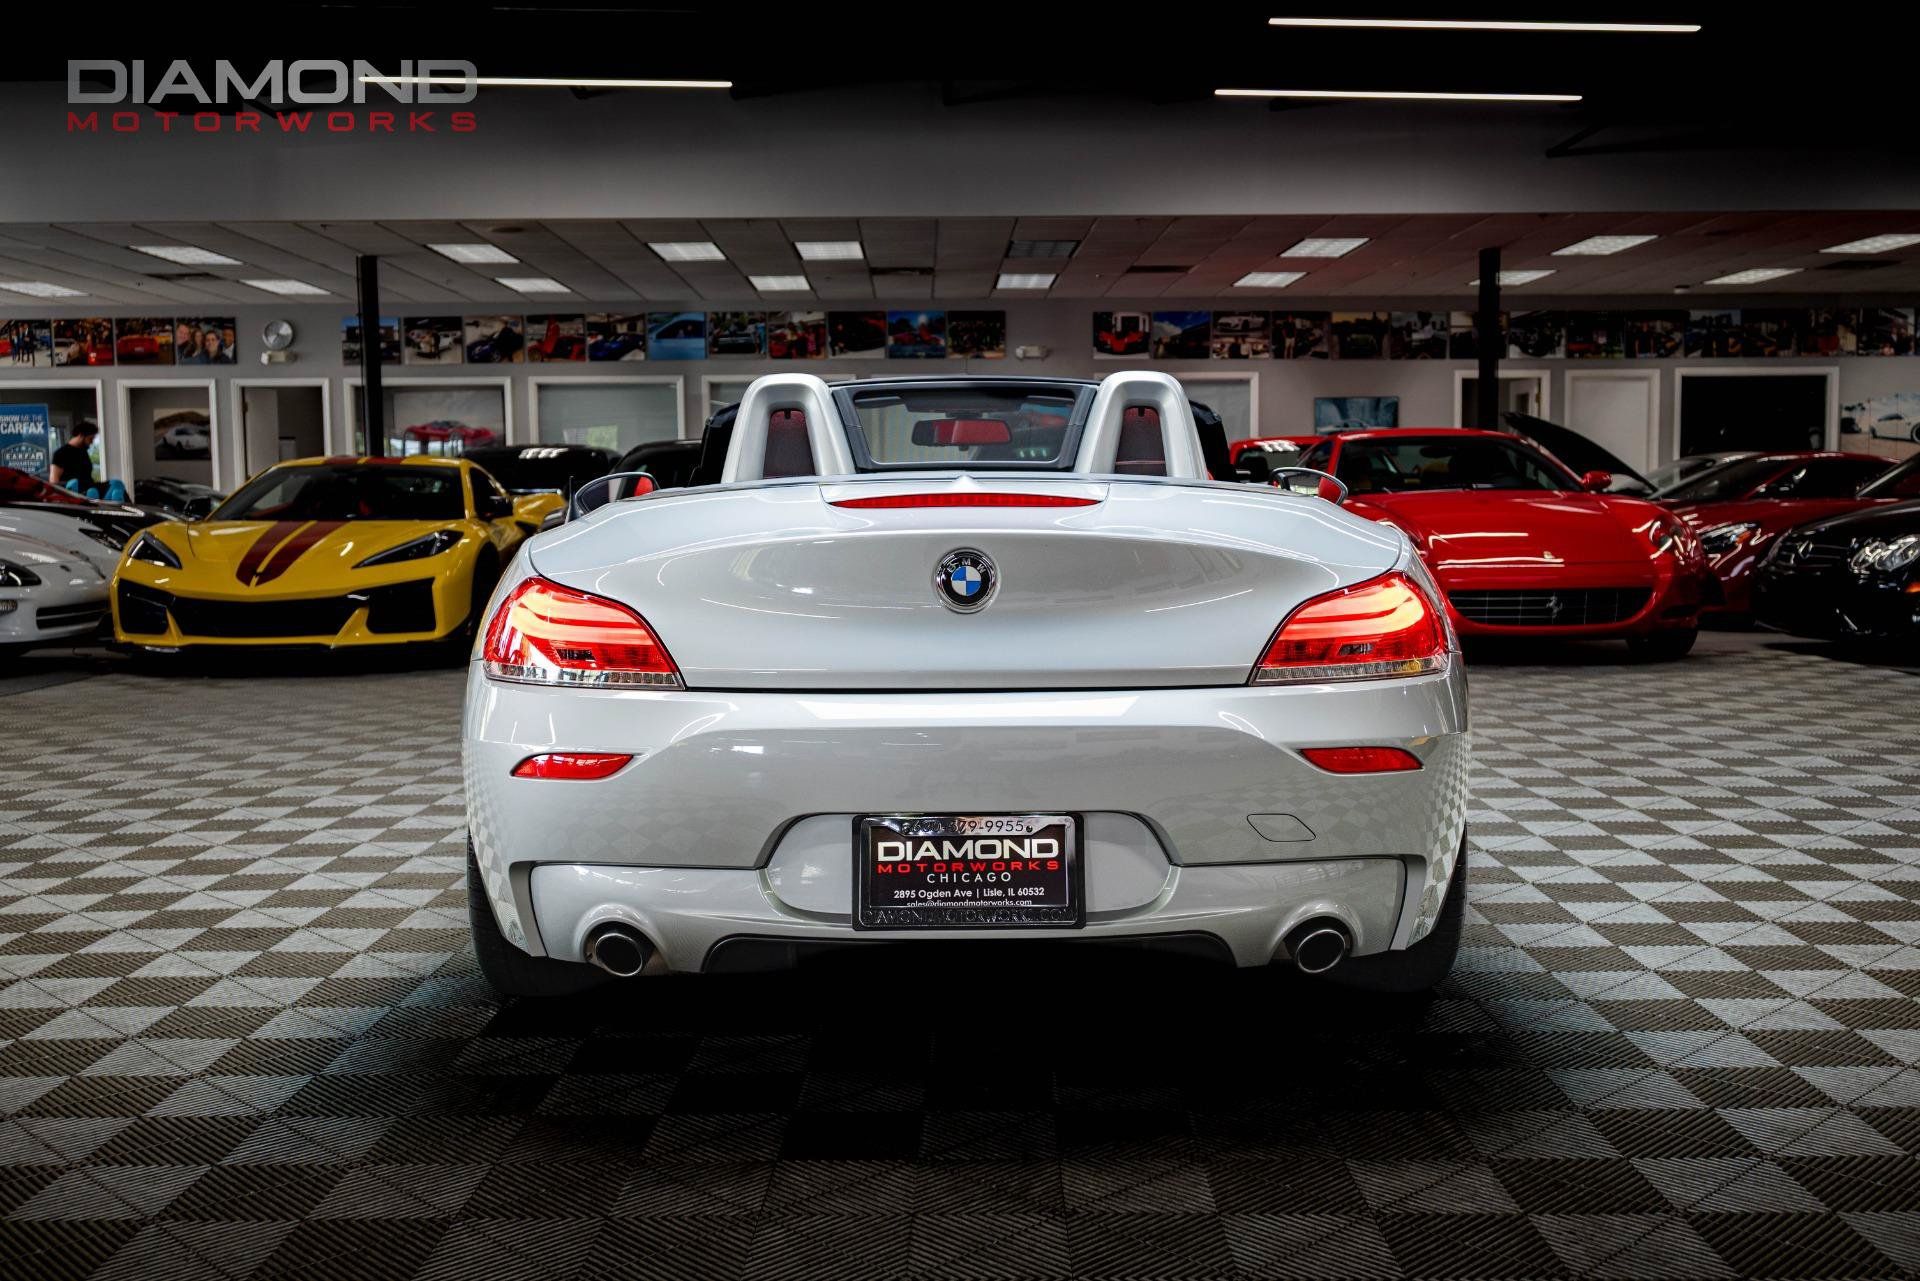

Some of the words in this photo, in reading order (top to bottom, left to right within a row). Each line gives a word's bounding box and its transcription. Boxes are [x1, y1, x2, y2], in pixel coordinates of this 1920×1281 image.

[0, 421, 44, 434] CARFAX
[946, 557, 987, 574] BMW
[912, 819, 1024, 833] 630-379-9955
[877, 838, 1059, 862] DIAMOND
[877, 861, 1060, 874] MOTORWORKS
[926, 871, 1012, 884] CHICAGO
[893, 890, 916, 899] 2895
[918, 889, 951, 900] Ogden
[953, 889, 973, 898] Ave
[983, 887, 1006, 898] Lisle,
[1007, 887, 1015, 897] IL
[1017, 886, 1045, 897] 60532
